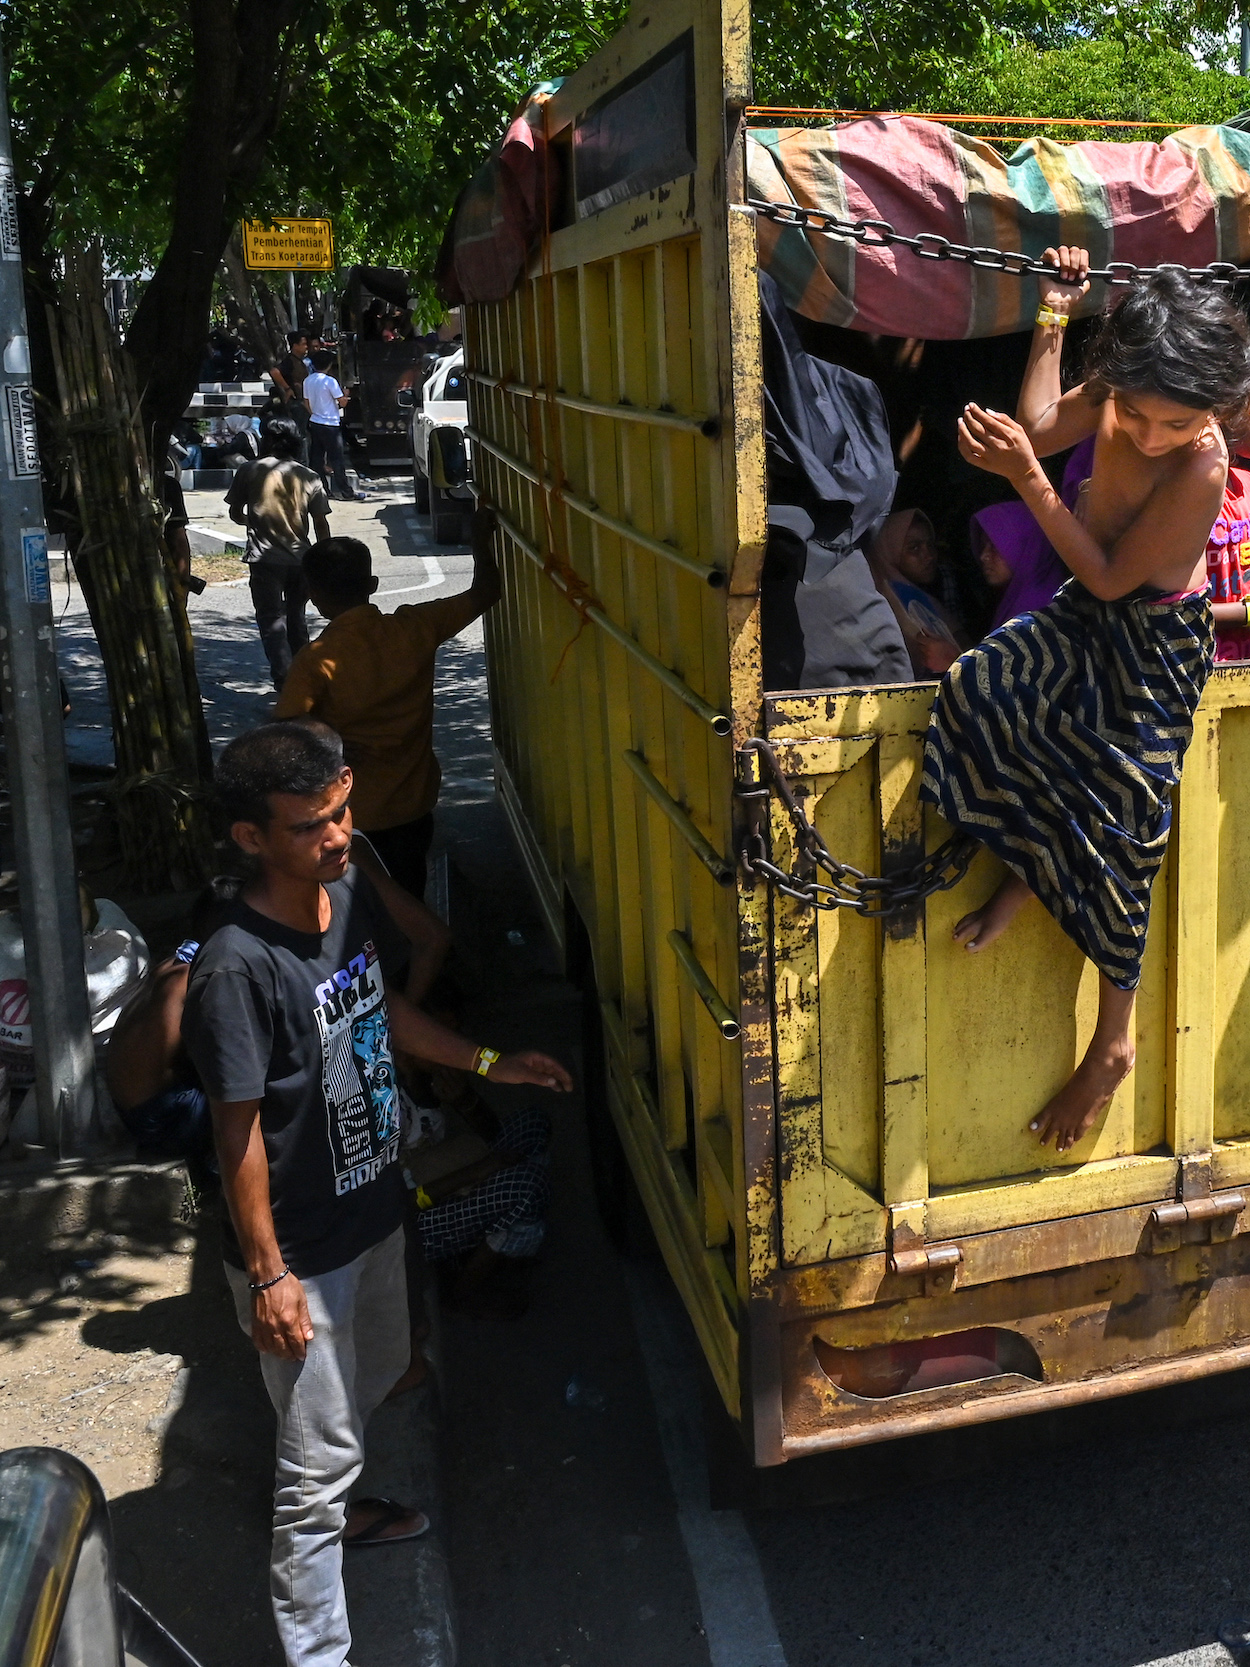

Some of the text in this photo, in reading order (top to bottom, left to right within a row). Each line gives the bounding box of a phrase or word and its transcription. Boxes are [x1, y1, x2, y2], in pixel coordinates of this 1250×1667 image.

[298, 225, 327, 235] Tempat
[253, 237, 324, 248] Pemberhentian
[251, 251, 328, 264] Trans Koetaradja
[25, 428, 37, 469] SEDOT
